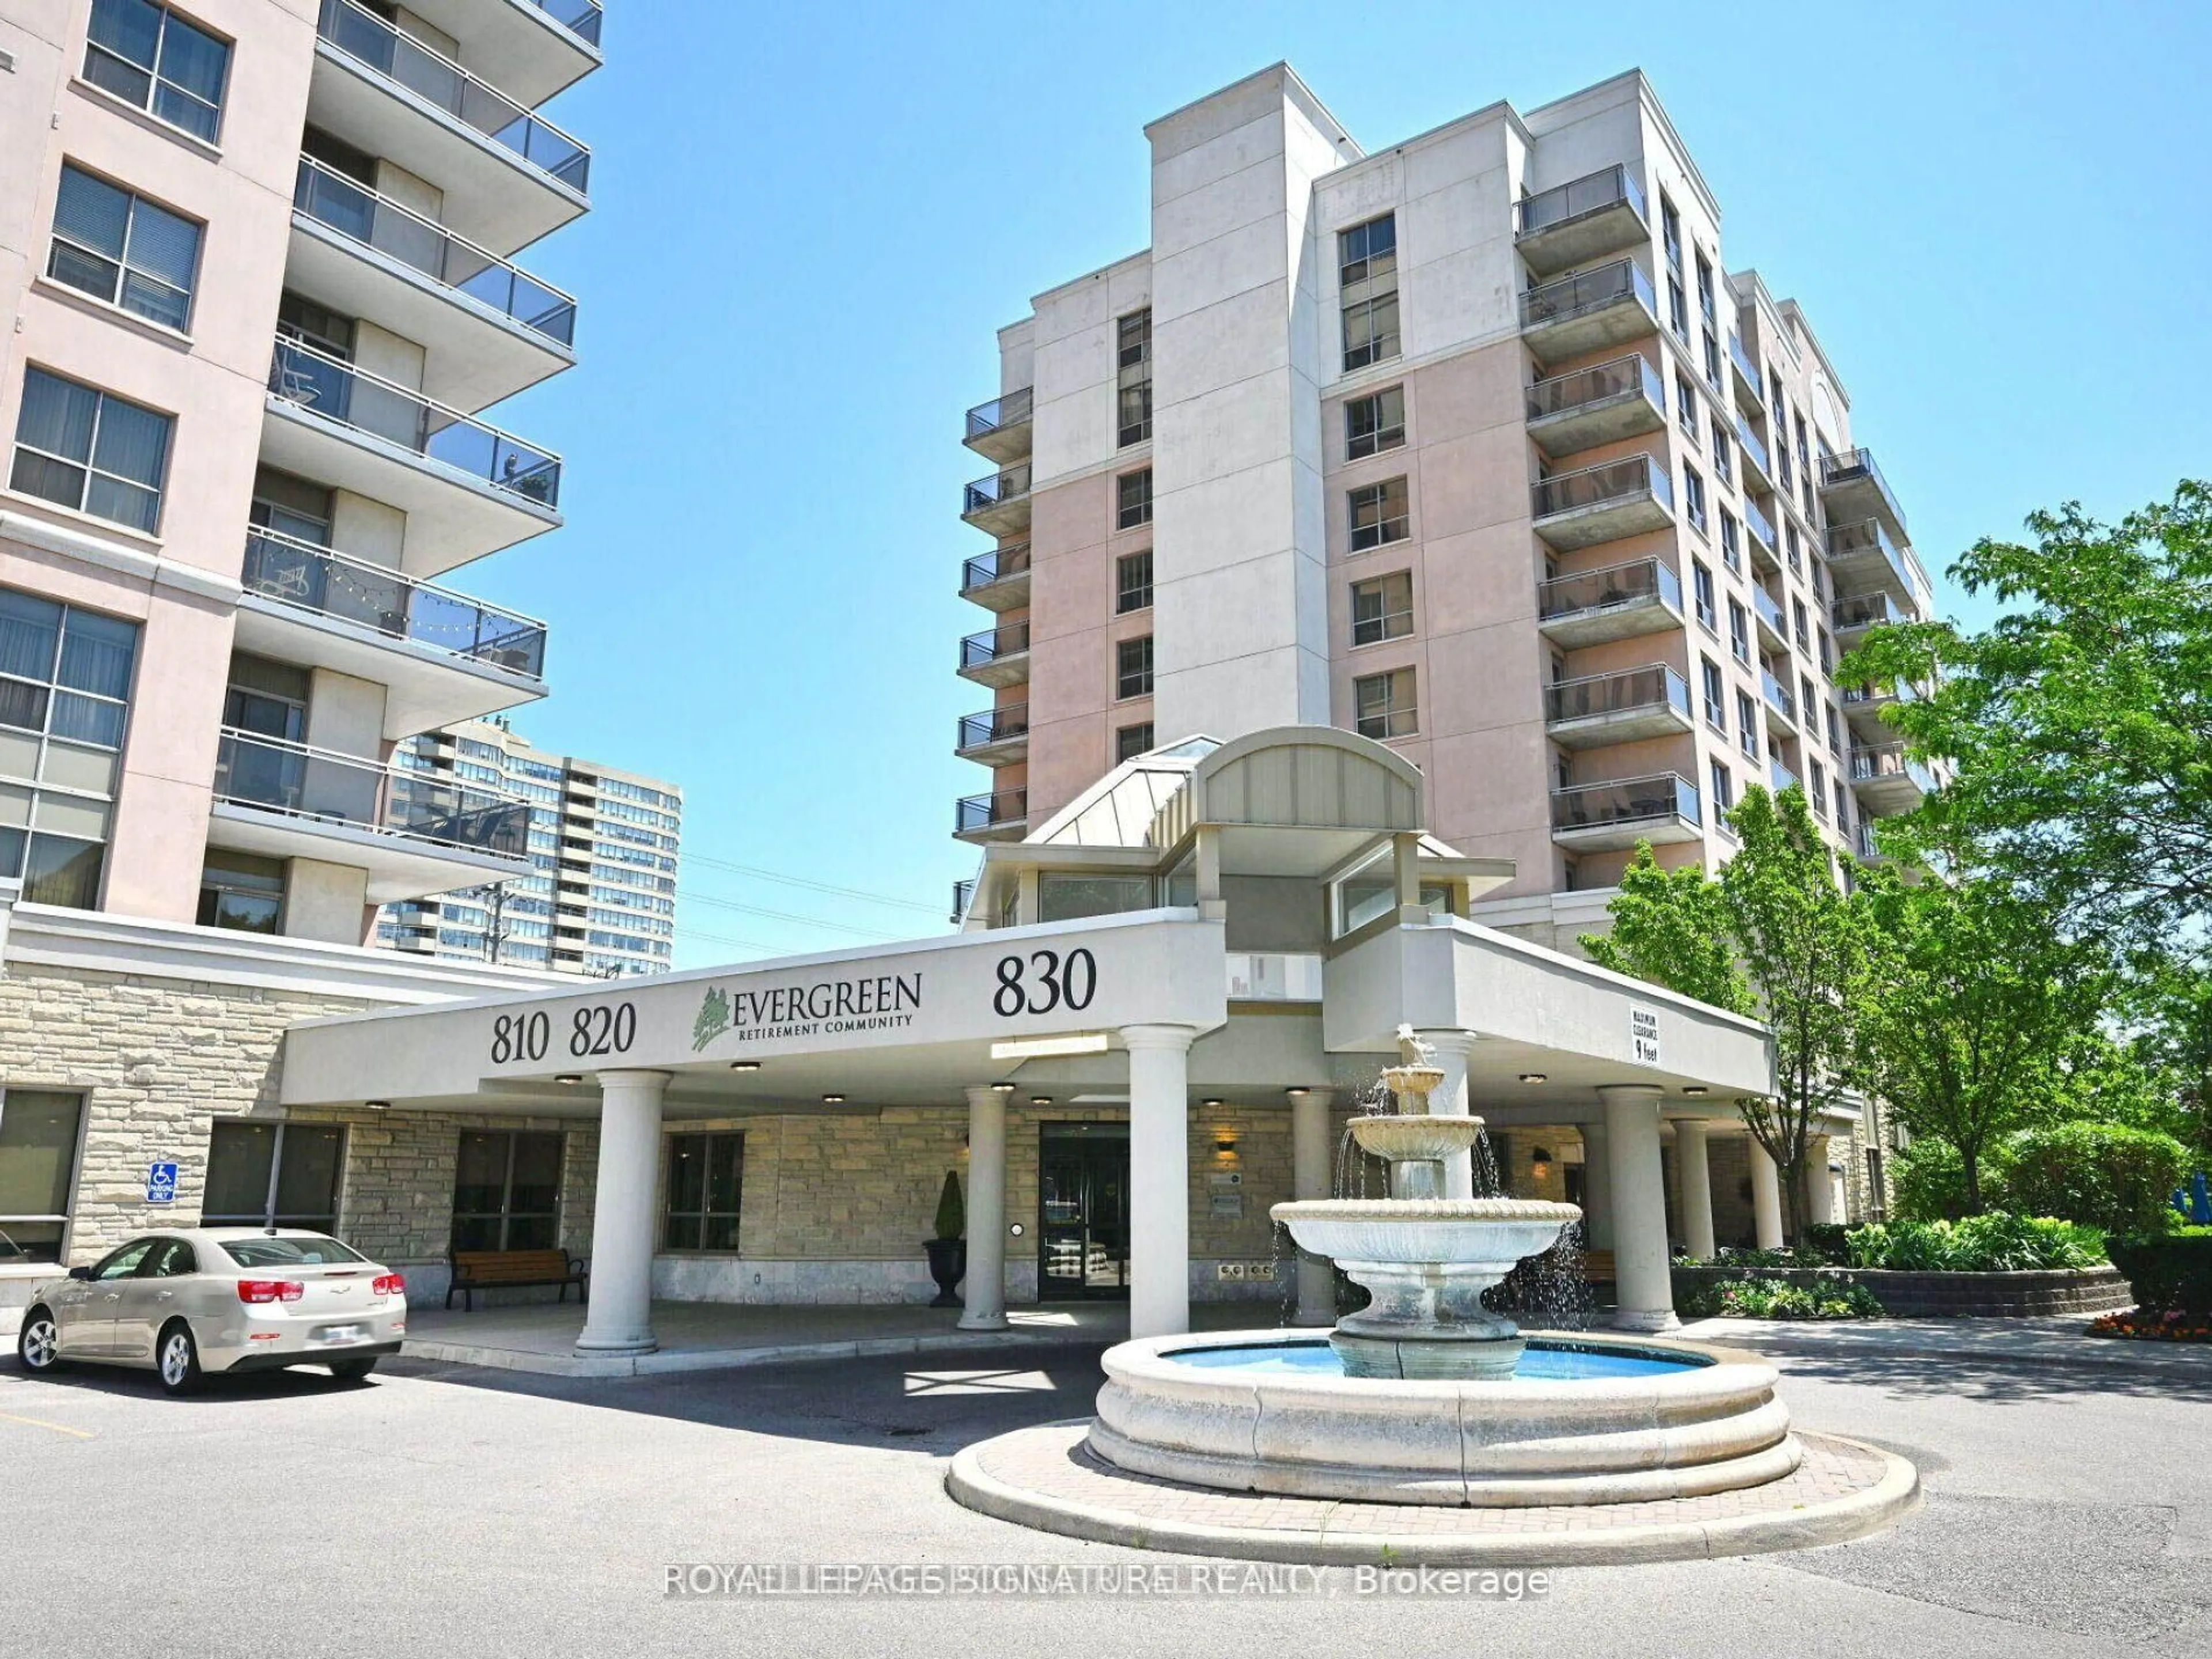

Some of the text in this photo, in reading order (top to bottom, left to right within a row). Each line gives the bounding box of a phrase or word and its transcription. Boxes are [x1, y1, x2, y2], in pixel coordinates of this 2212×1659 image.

[733, 974, 922, 1027] EVERGREEN
[994, 948, 1096, 1017] 830
[491, 1003, 636, 1063] 810 820
[738, 1014, 914, 1041] RETIREMENT COMMUNITY
[1636, 1039, 1641, 1059] 9
